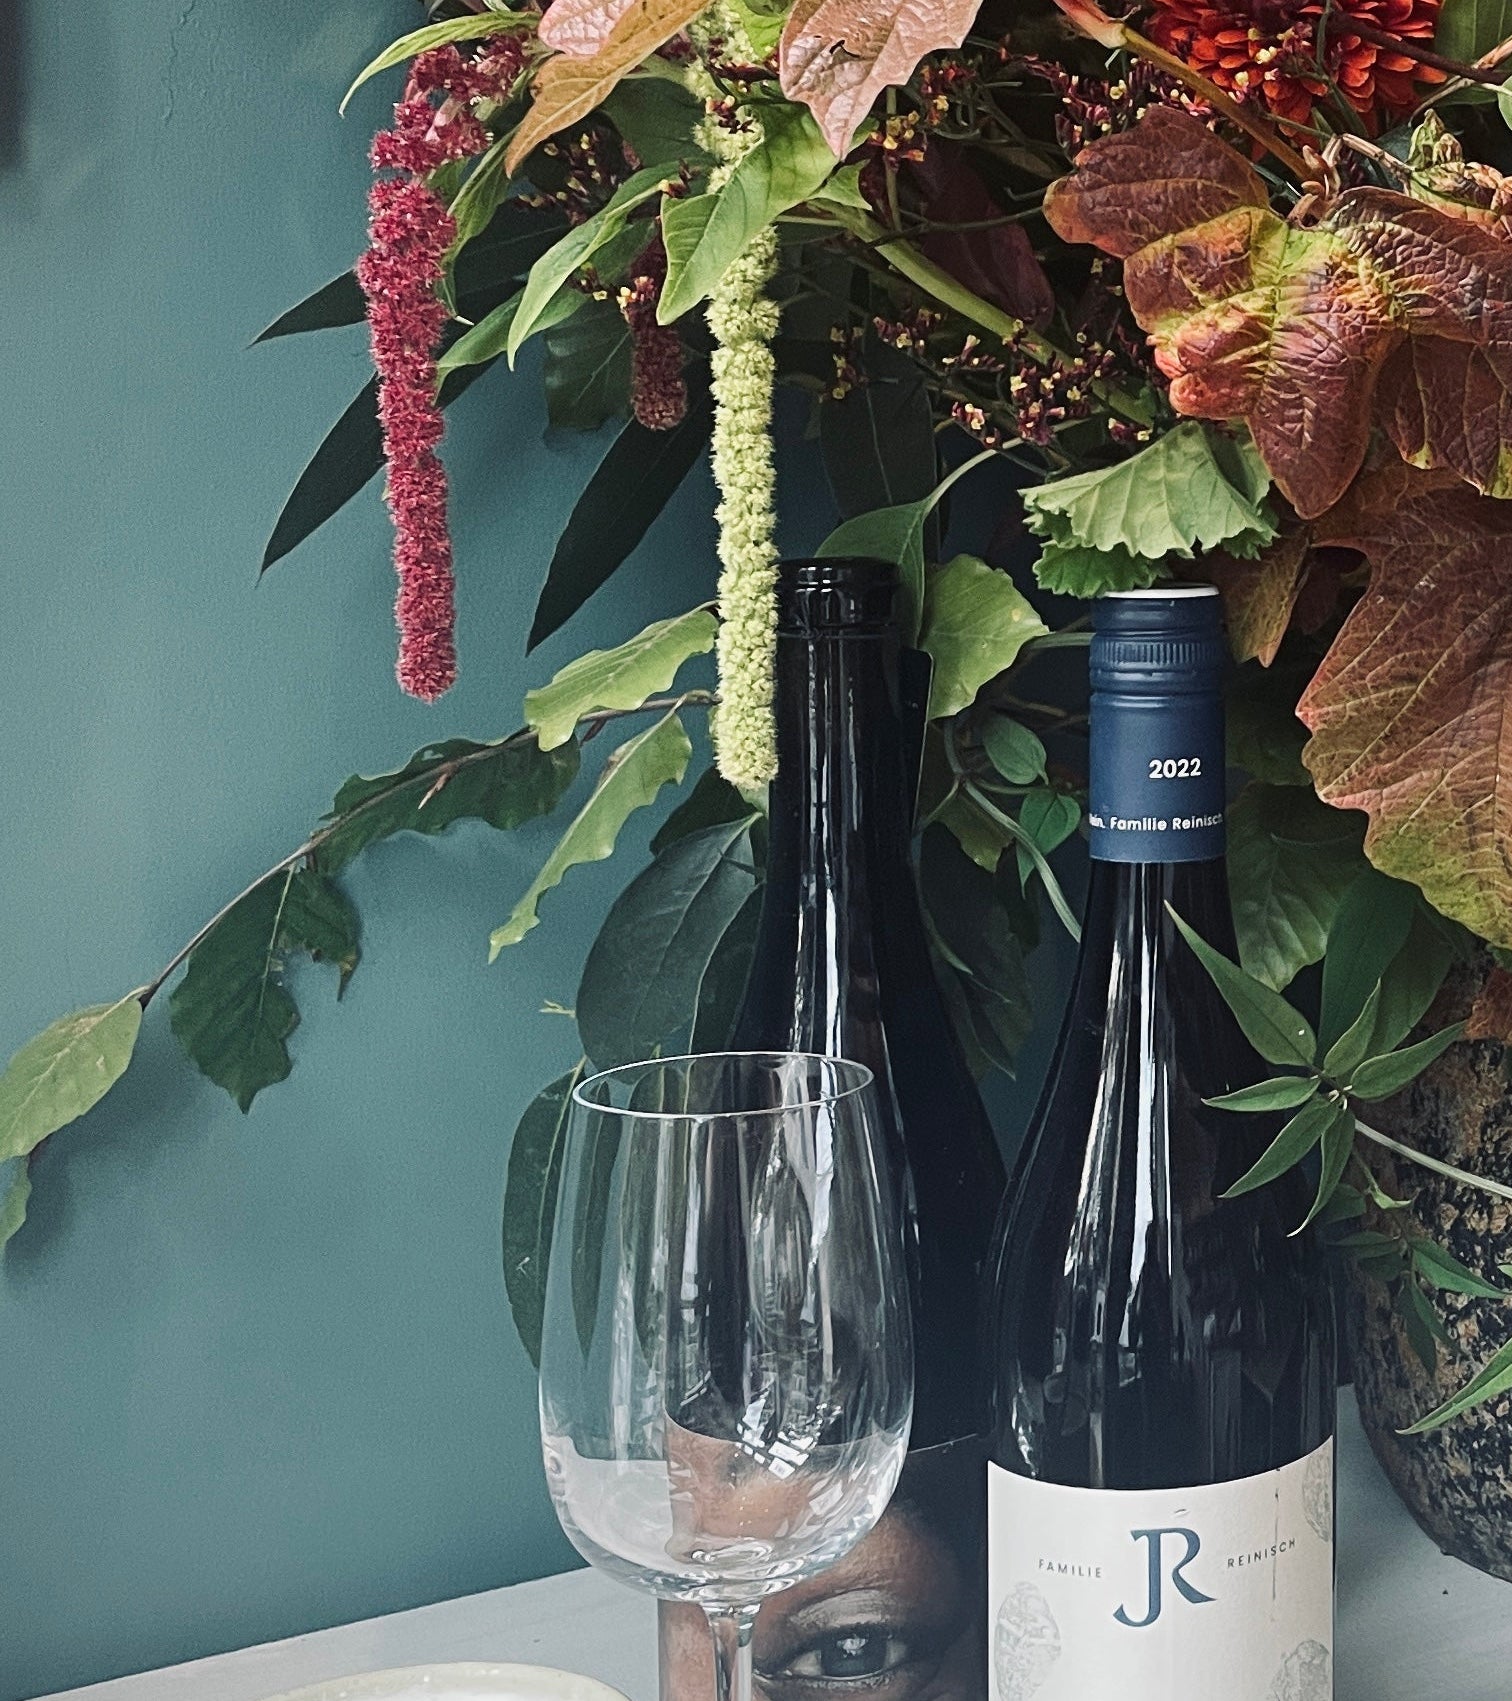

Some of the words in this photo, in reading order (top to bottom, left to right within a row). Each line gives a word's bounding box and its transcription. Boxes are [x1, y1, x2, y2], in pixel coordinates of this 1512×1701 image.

[1148, 758, 1202, 779] 2022
[1110, 816, 1167, 831] Familie
[1037, 1558, 1103, 1579] FAMILIE
[1112, 1527, 1216, 1628] JR
[1227, 1537, 1297, 1569] REINISCH
